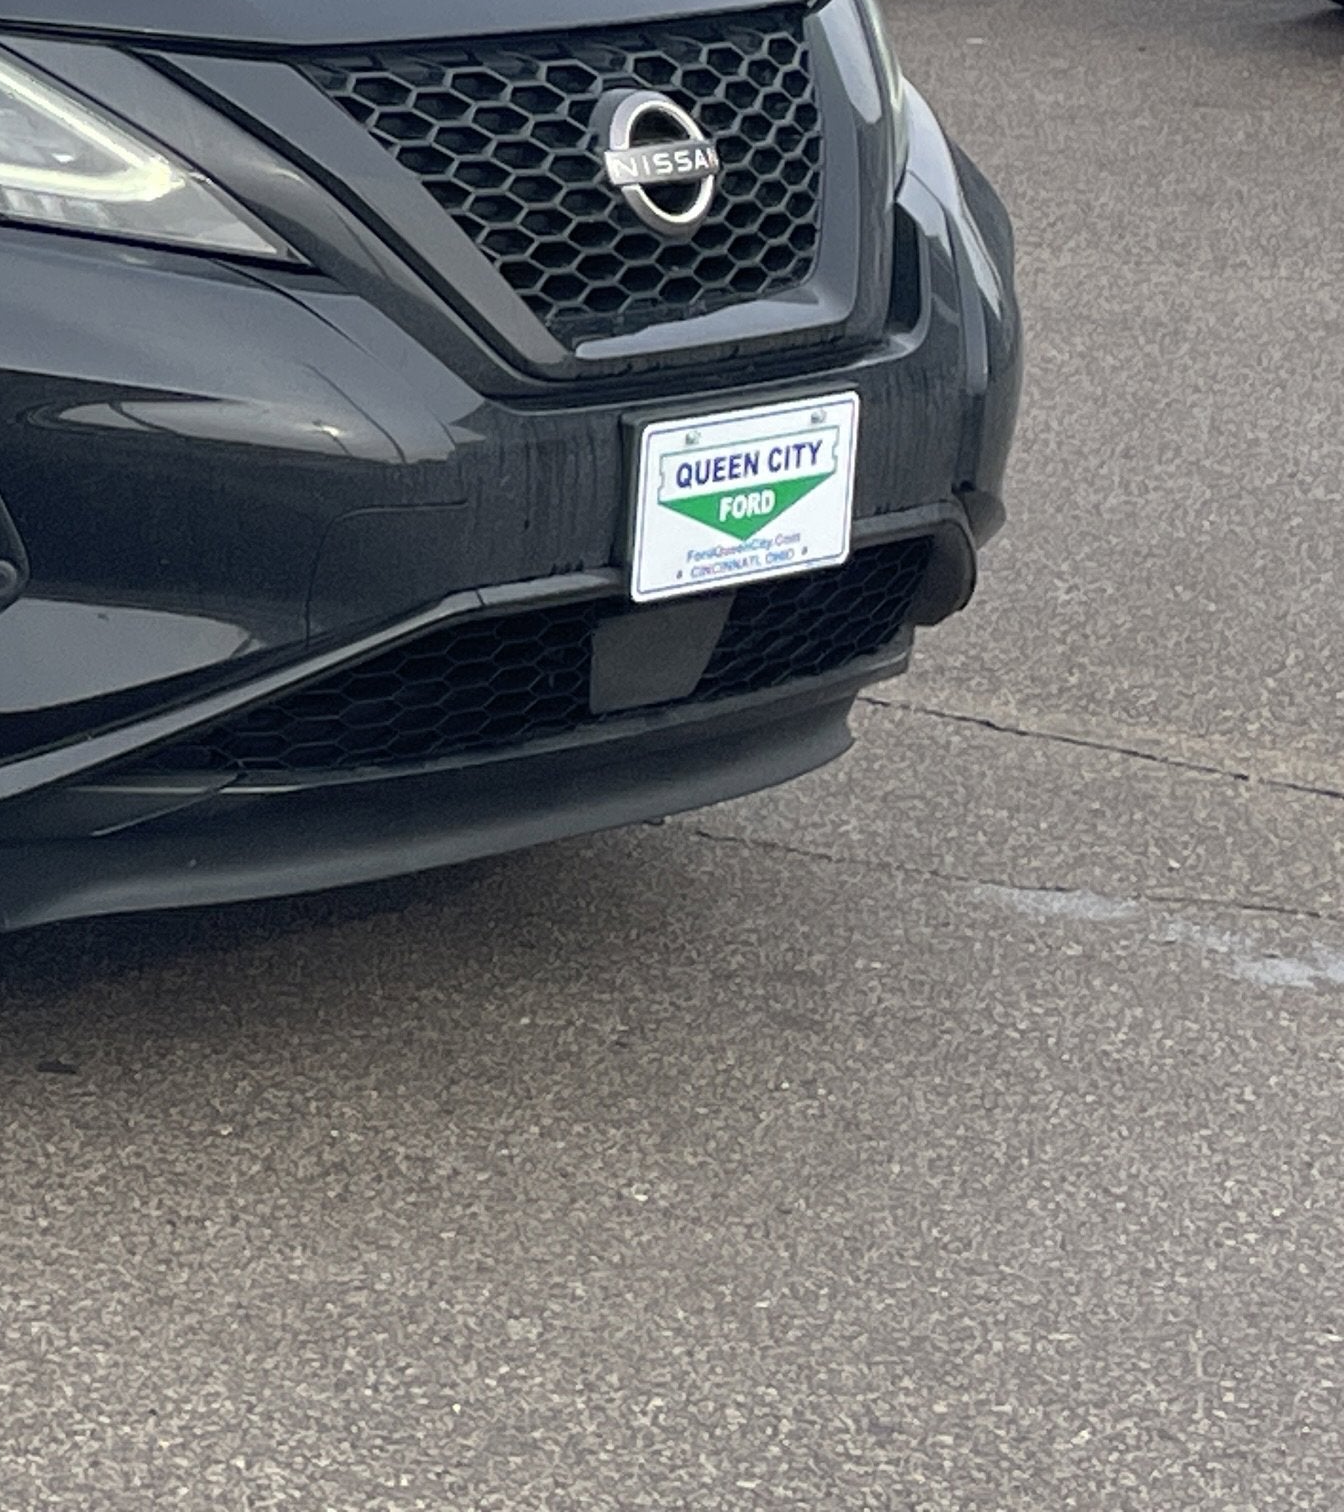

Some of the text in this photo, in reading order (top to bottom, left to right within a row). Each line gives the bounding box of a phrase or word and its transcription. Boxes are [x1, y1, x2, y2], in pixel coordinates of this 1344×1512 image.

[613, 147, 719, 180] NISSAN
[676, 440, 823, 488] QUEEN CITY
[719, 489, 775, 522] FORD
